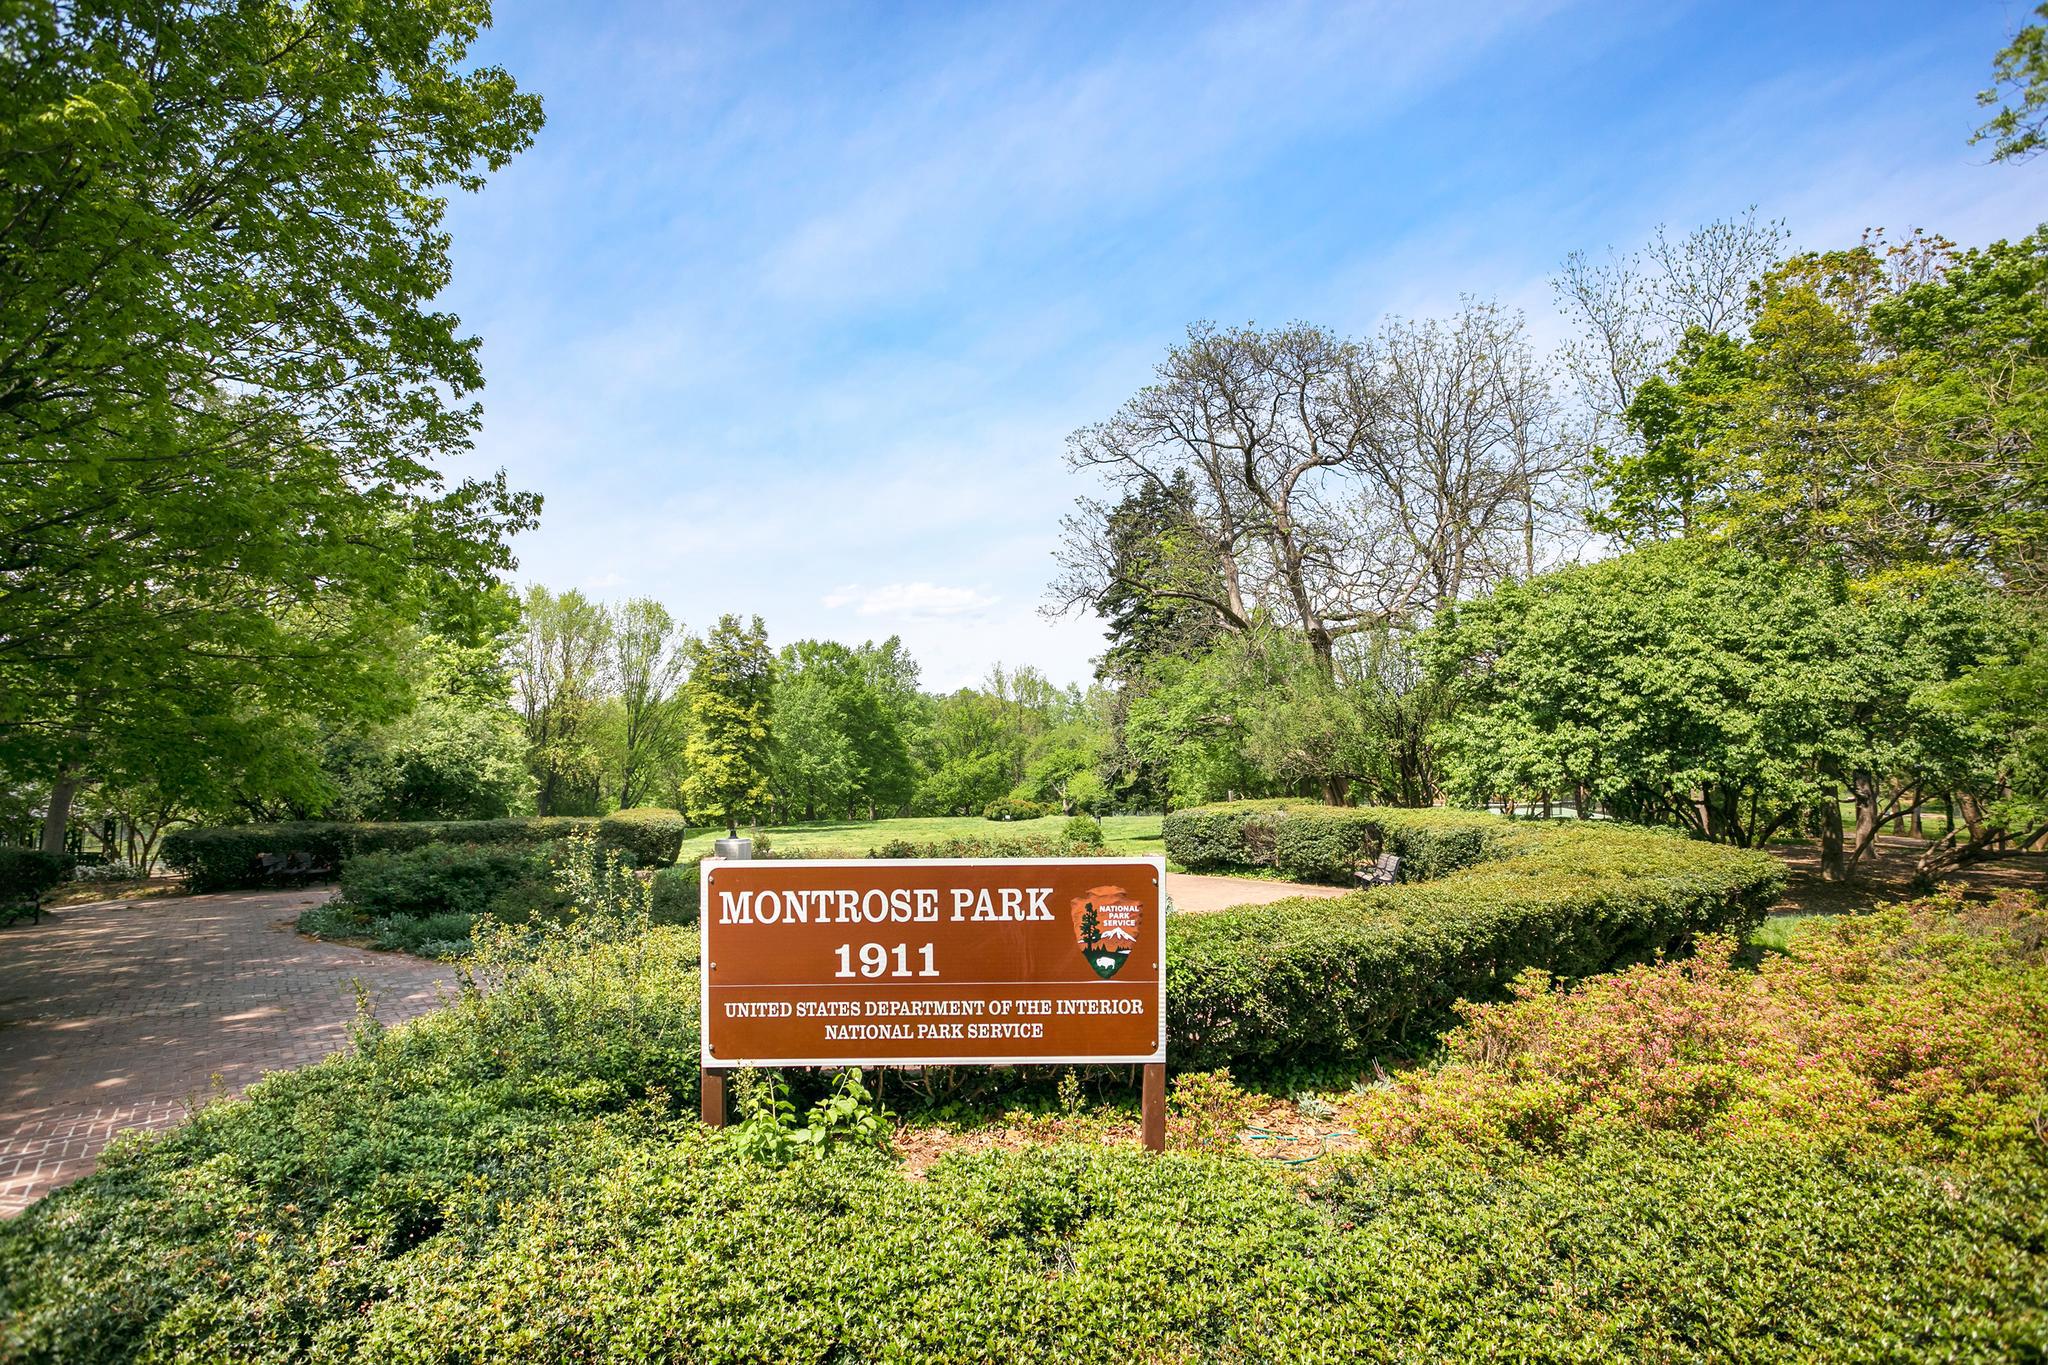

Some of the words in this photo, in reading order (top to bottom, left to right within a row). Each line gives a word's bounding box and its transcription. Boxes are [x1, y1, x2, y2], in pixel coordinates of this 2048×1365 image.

[719, 889, 938, 924] MONTROSE
[951, 888, 1055, 921] PARK
[1103, 919, 1135, 927] SERVICE
[835, 943, 939, 977] 1911
[724, 1002, 792, 1017] UNITED
[797, 1002, 860, 1017] STATES
[865, 1001, 985, 1016] DEPARTMENT
[989, 1001, 1012, 1015] OF
[1016, 1000, 1051, 1014] THE
[1057, 1000, 1143, 1014] INTERIOR
[825, 1025, 913, 1039] NATIONAL
[918, 1024, 964, 1038] PARK
[968, 1023, 1043, 1038] SERVICE
